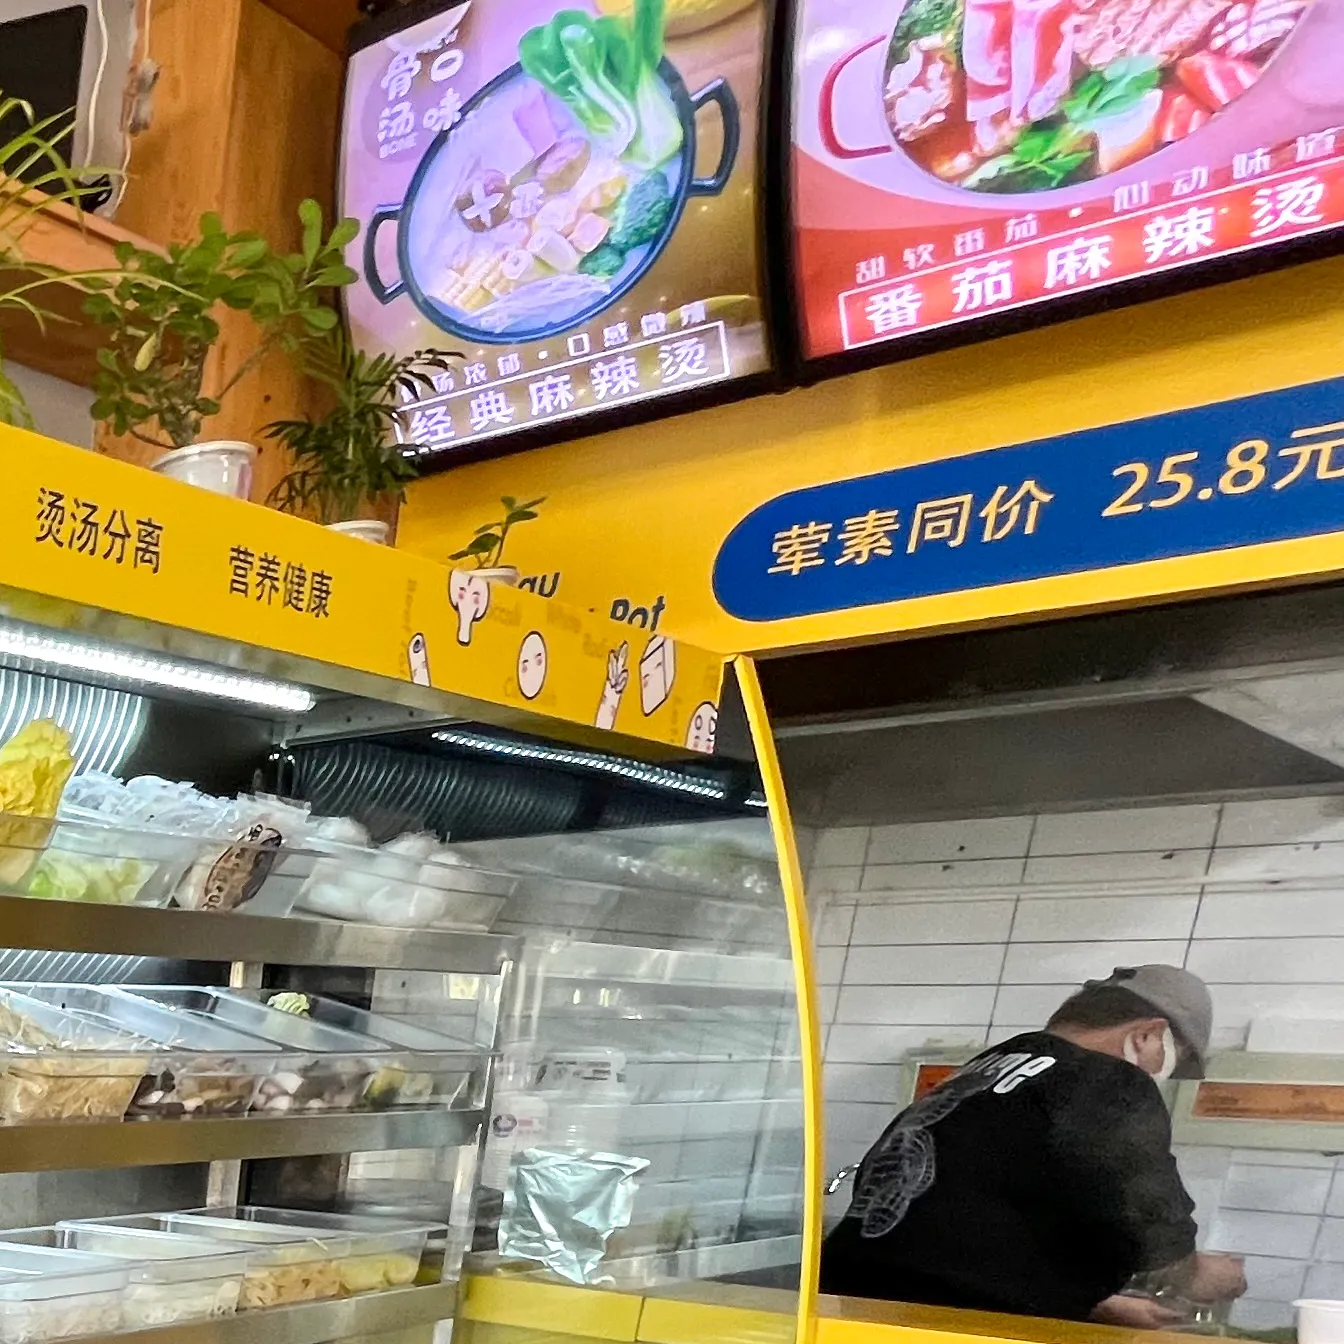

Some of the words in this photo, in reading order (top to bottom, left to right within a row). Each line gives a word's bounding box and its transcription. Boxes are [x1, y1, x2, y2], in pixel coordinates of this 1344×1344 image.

[864, 176, 1326, 336] 番茄麻辣烫
[411, 336, 711, 445] 经典麻辣烫
[34, 486, 163, 575] 烫汤分离
[227, 545, 333, 618] 营养健康
[767, 480, 1054, 577] 荤素同价
[1101, 421, 1344, 518] 25.8元
